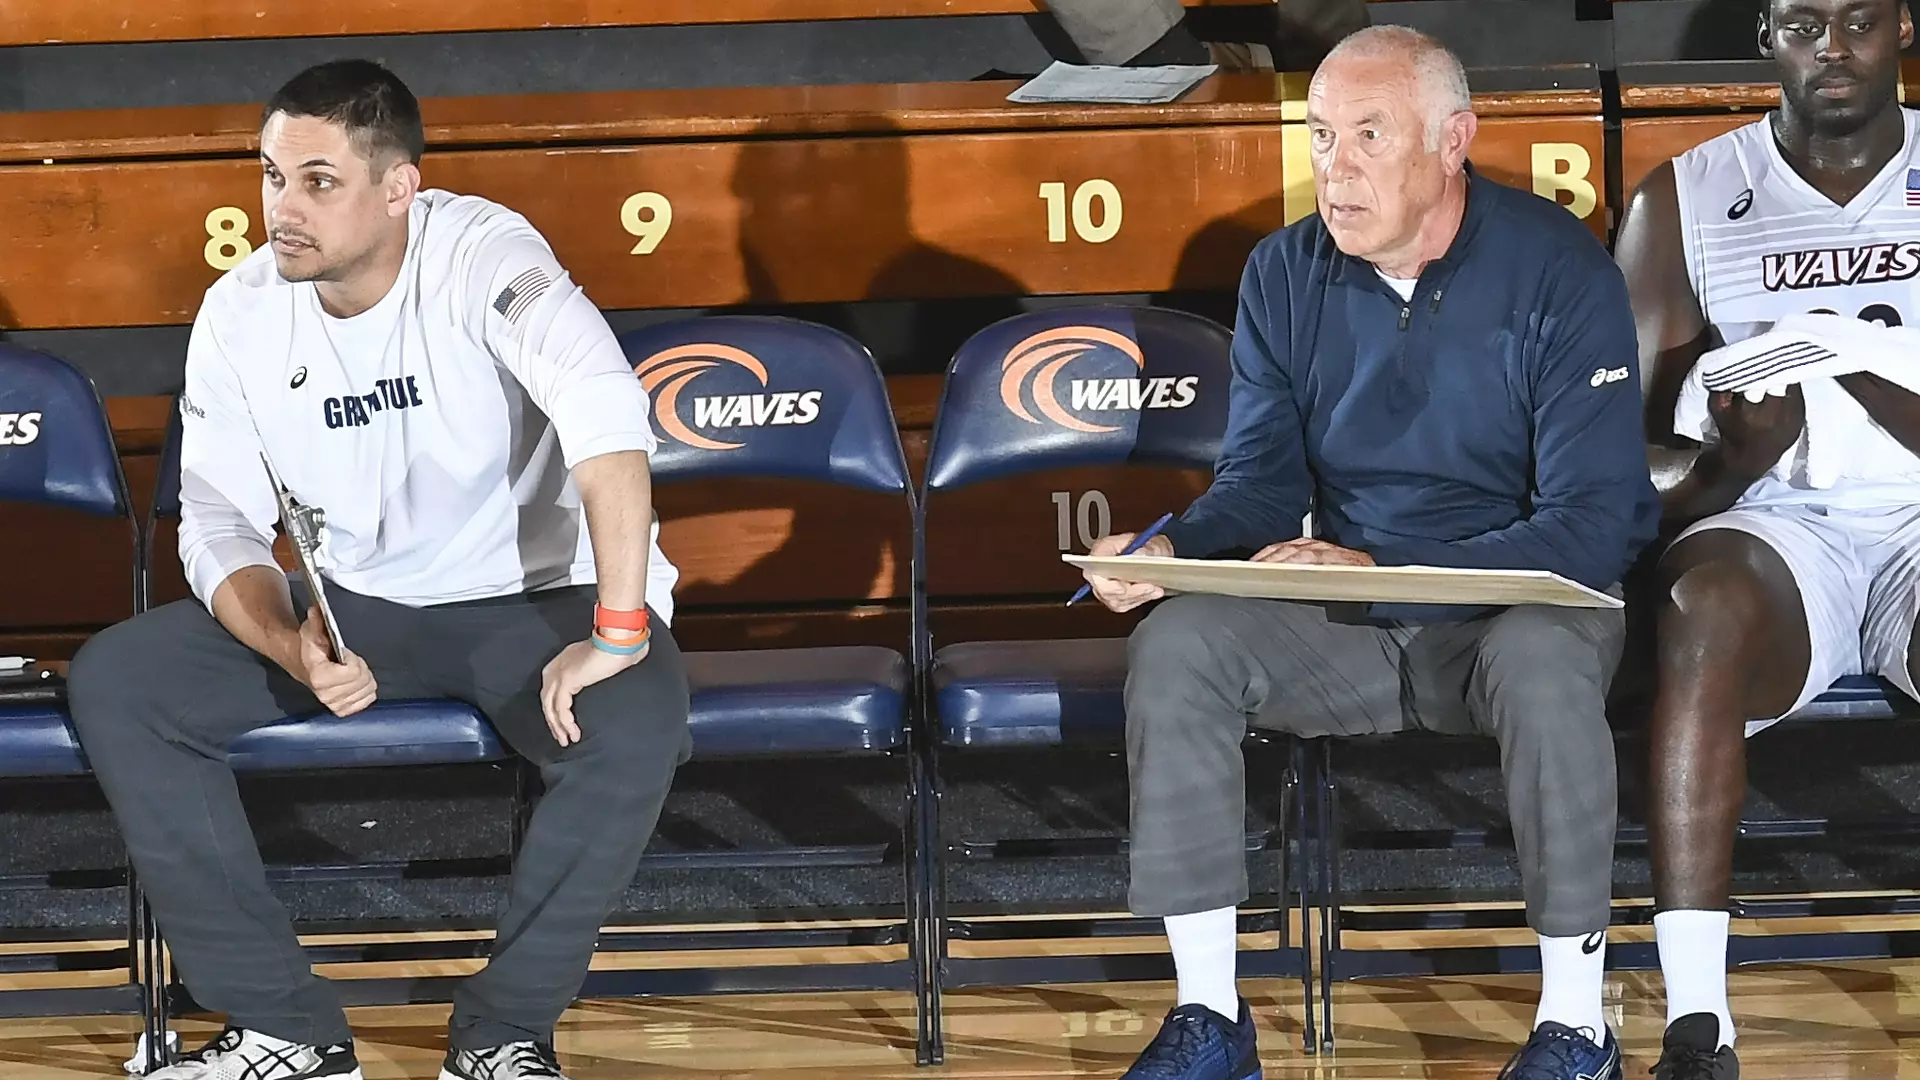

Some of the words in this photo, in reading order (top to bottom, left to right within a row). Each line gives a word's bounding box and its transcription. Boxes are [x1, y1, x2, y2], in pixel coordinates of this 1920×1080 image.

[1038, 179, 1123, 243] 10
[1531, 142, 1597, 219] B
[204, 206, 252, 271] 8
[620, 192, 672, 253] 9
[1762, 241, 1920, 292] WAVES
[694, 390, 823, 429] WAVES
[1071, 376, 1199, 410] WAVES
[1052, 489, 1111, 550] 10
